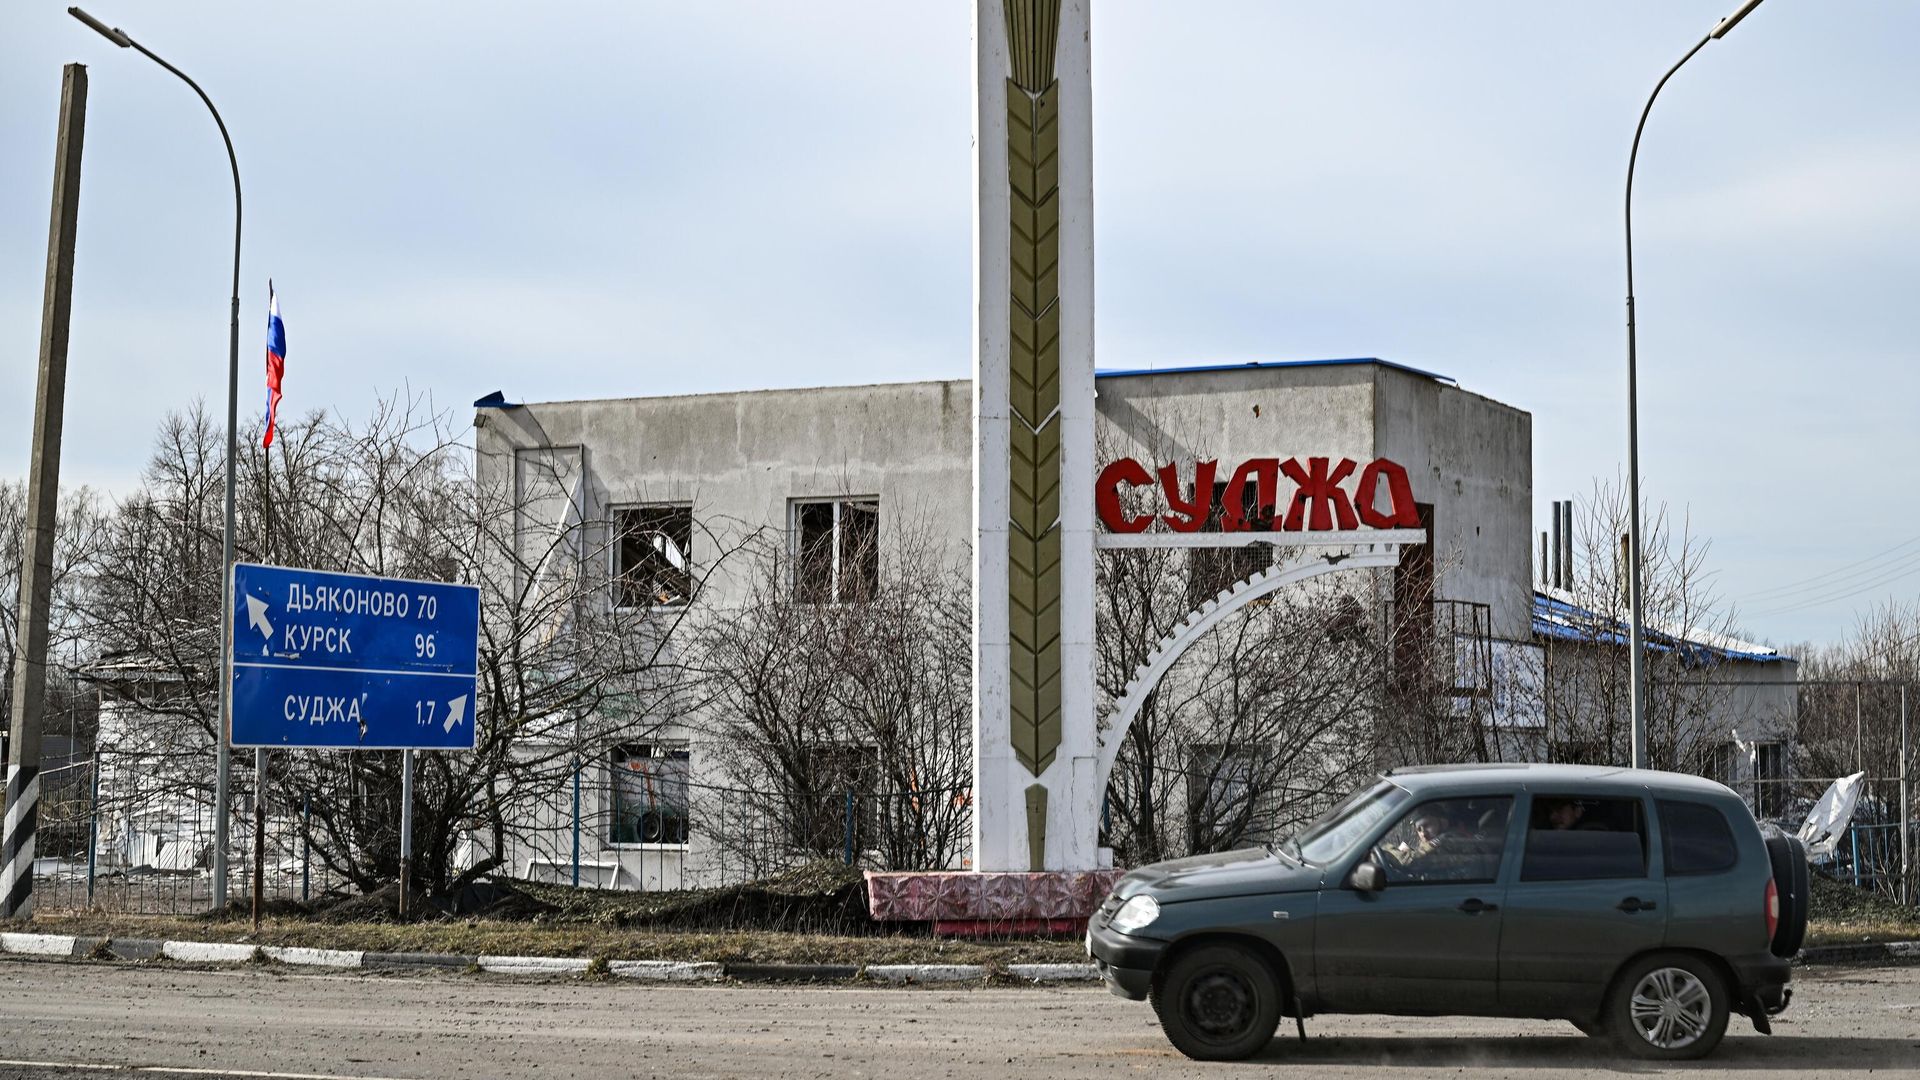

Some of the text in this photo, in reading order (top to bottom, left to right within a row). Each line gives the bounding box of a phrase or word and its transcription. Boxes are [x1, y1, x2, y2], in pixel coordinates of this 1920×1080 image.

[286, 583, 437, 620] ДЬЯКОНОВО 70
[284, 624, 436, 658] КУРСК 96
[284, 695, 436, 727] СУДЖА 1,7
